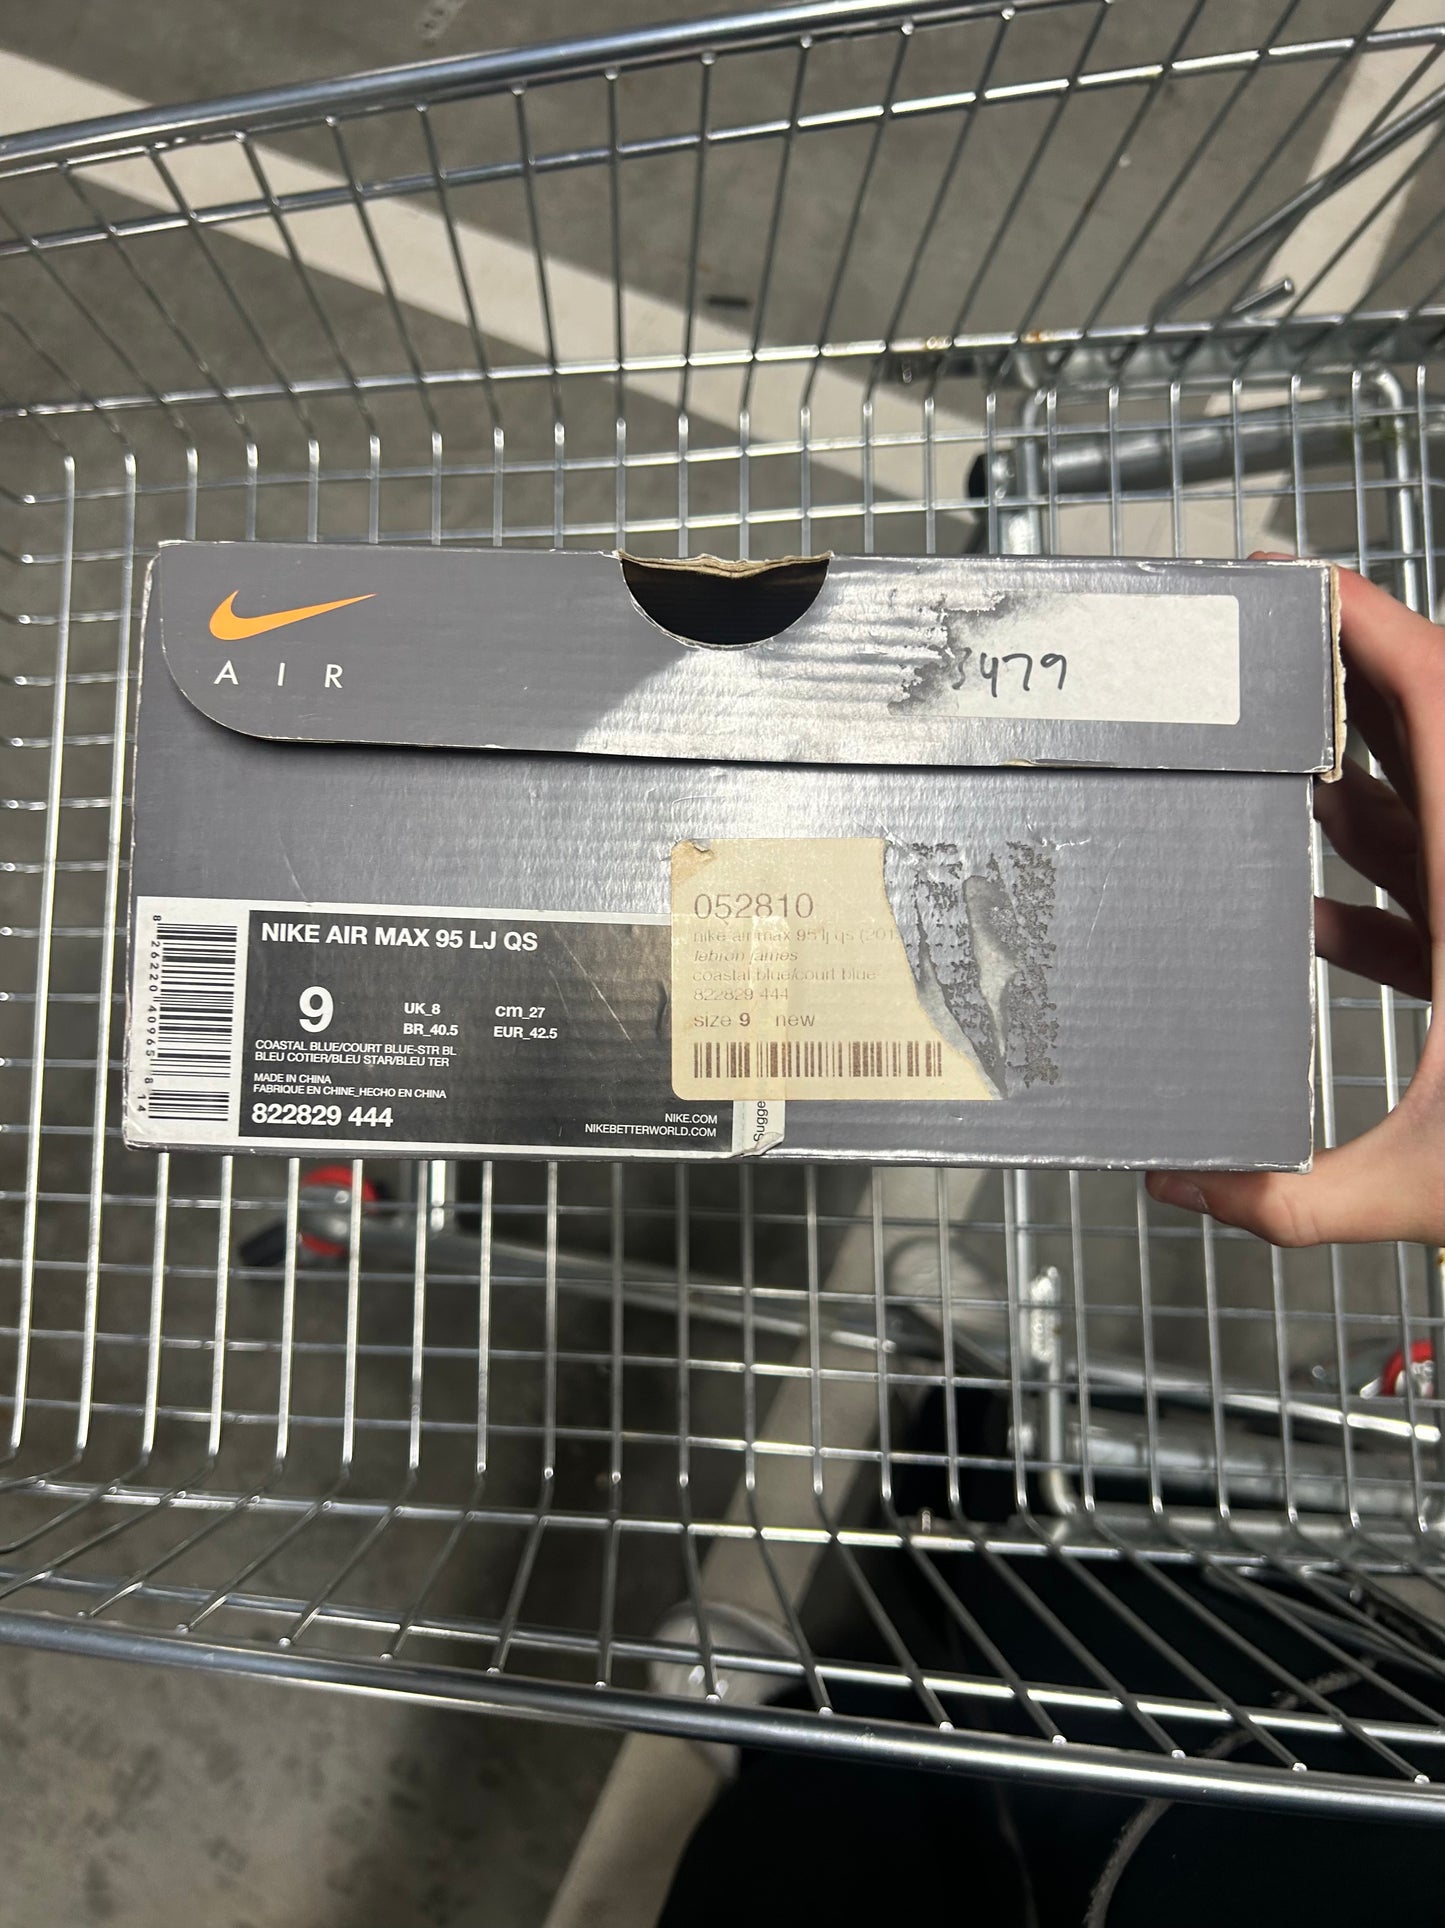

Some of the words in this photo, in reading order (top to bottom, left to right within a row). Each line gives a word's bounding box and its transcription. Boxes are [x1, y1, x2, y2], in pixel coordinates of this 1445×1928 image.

[213, 659, 343, 689] AIR
[694, 892, 814, 919] 052810
[261, 922, 320, 943] NIKE
[325, 925, 368, 945] AIR
[375, 926, 430, 948] MAX
[435, 928, 463, 949] 95
[469, 930, 496, 950] LJ
[503, 931, 538, 952] QS
[693, 929, 727, 942] nike
[757, 929, 790, 942] max
[149, 941, 161, 992] 26220
[692, 968, 751, 982] coastal
[694, 987, 753, 1000] 822829
[759, 988, 789, 1000] 444
[299, 986, 334, 1033] 9
[404, 1002, 441, 1017] UK_8
[494, 1005, 546, 1020] cm_27
[694, 1012, 732, 1027] size
[738, 1012, 751, 1027] 9
[775, 1013, 815, 1027] new
[145, 1005, 157, 1057] 40965
[403, 1022, 459, 1037] BR_40.5
[493, 1025, 558, 1040] EUR_42.5
[255, 1039, 308, 1051] COASTAL
[309, 1041, 382, 1053] BLUE/COURT
[384, 1044, 440, 1056] BLUE-STR
[442, 1046, 457, 1056] BL
[254, 1052, 285, 1062] BLEU
[286, 1053, 361, 1064] COTIER/BLEU
[363, 1055, 425, 1066] STAR/BLEU
[427, 1057, 450, 1067] TER
[254, 1073, 284, 1083] MADE
[286, 1074, 297, 1083] IN
[299, 1074, 332, 1084] CHINA
[253, 1084, 305, 1095] FABRIQUE
[306, 1085, 321, 1095] EN
[322, 1086, 396, 1098] CHINE_HECHO
[398, 1088, 413, 1098] EN
[414, 1089, 447, 1099] CHINA
[137, 1094, 146, 1112] 14
[251, 1103, 342, 1126] 822829
[347, 1106, 394, 1128] 444
[665, 1113, 718, 1124] NIKE.COM
[585, 1124, 717, 1137] NIKEBETTERWORLD.COM
